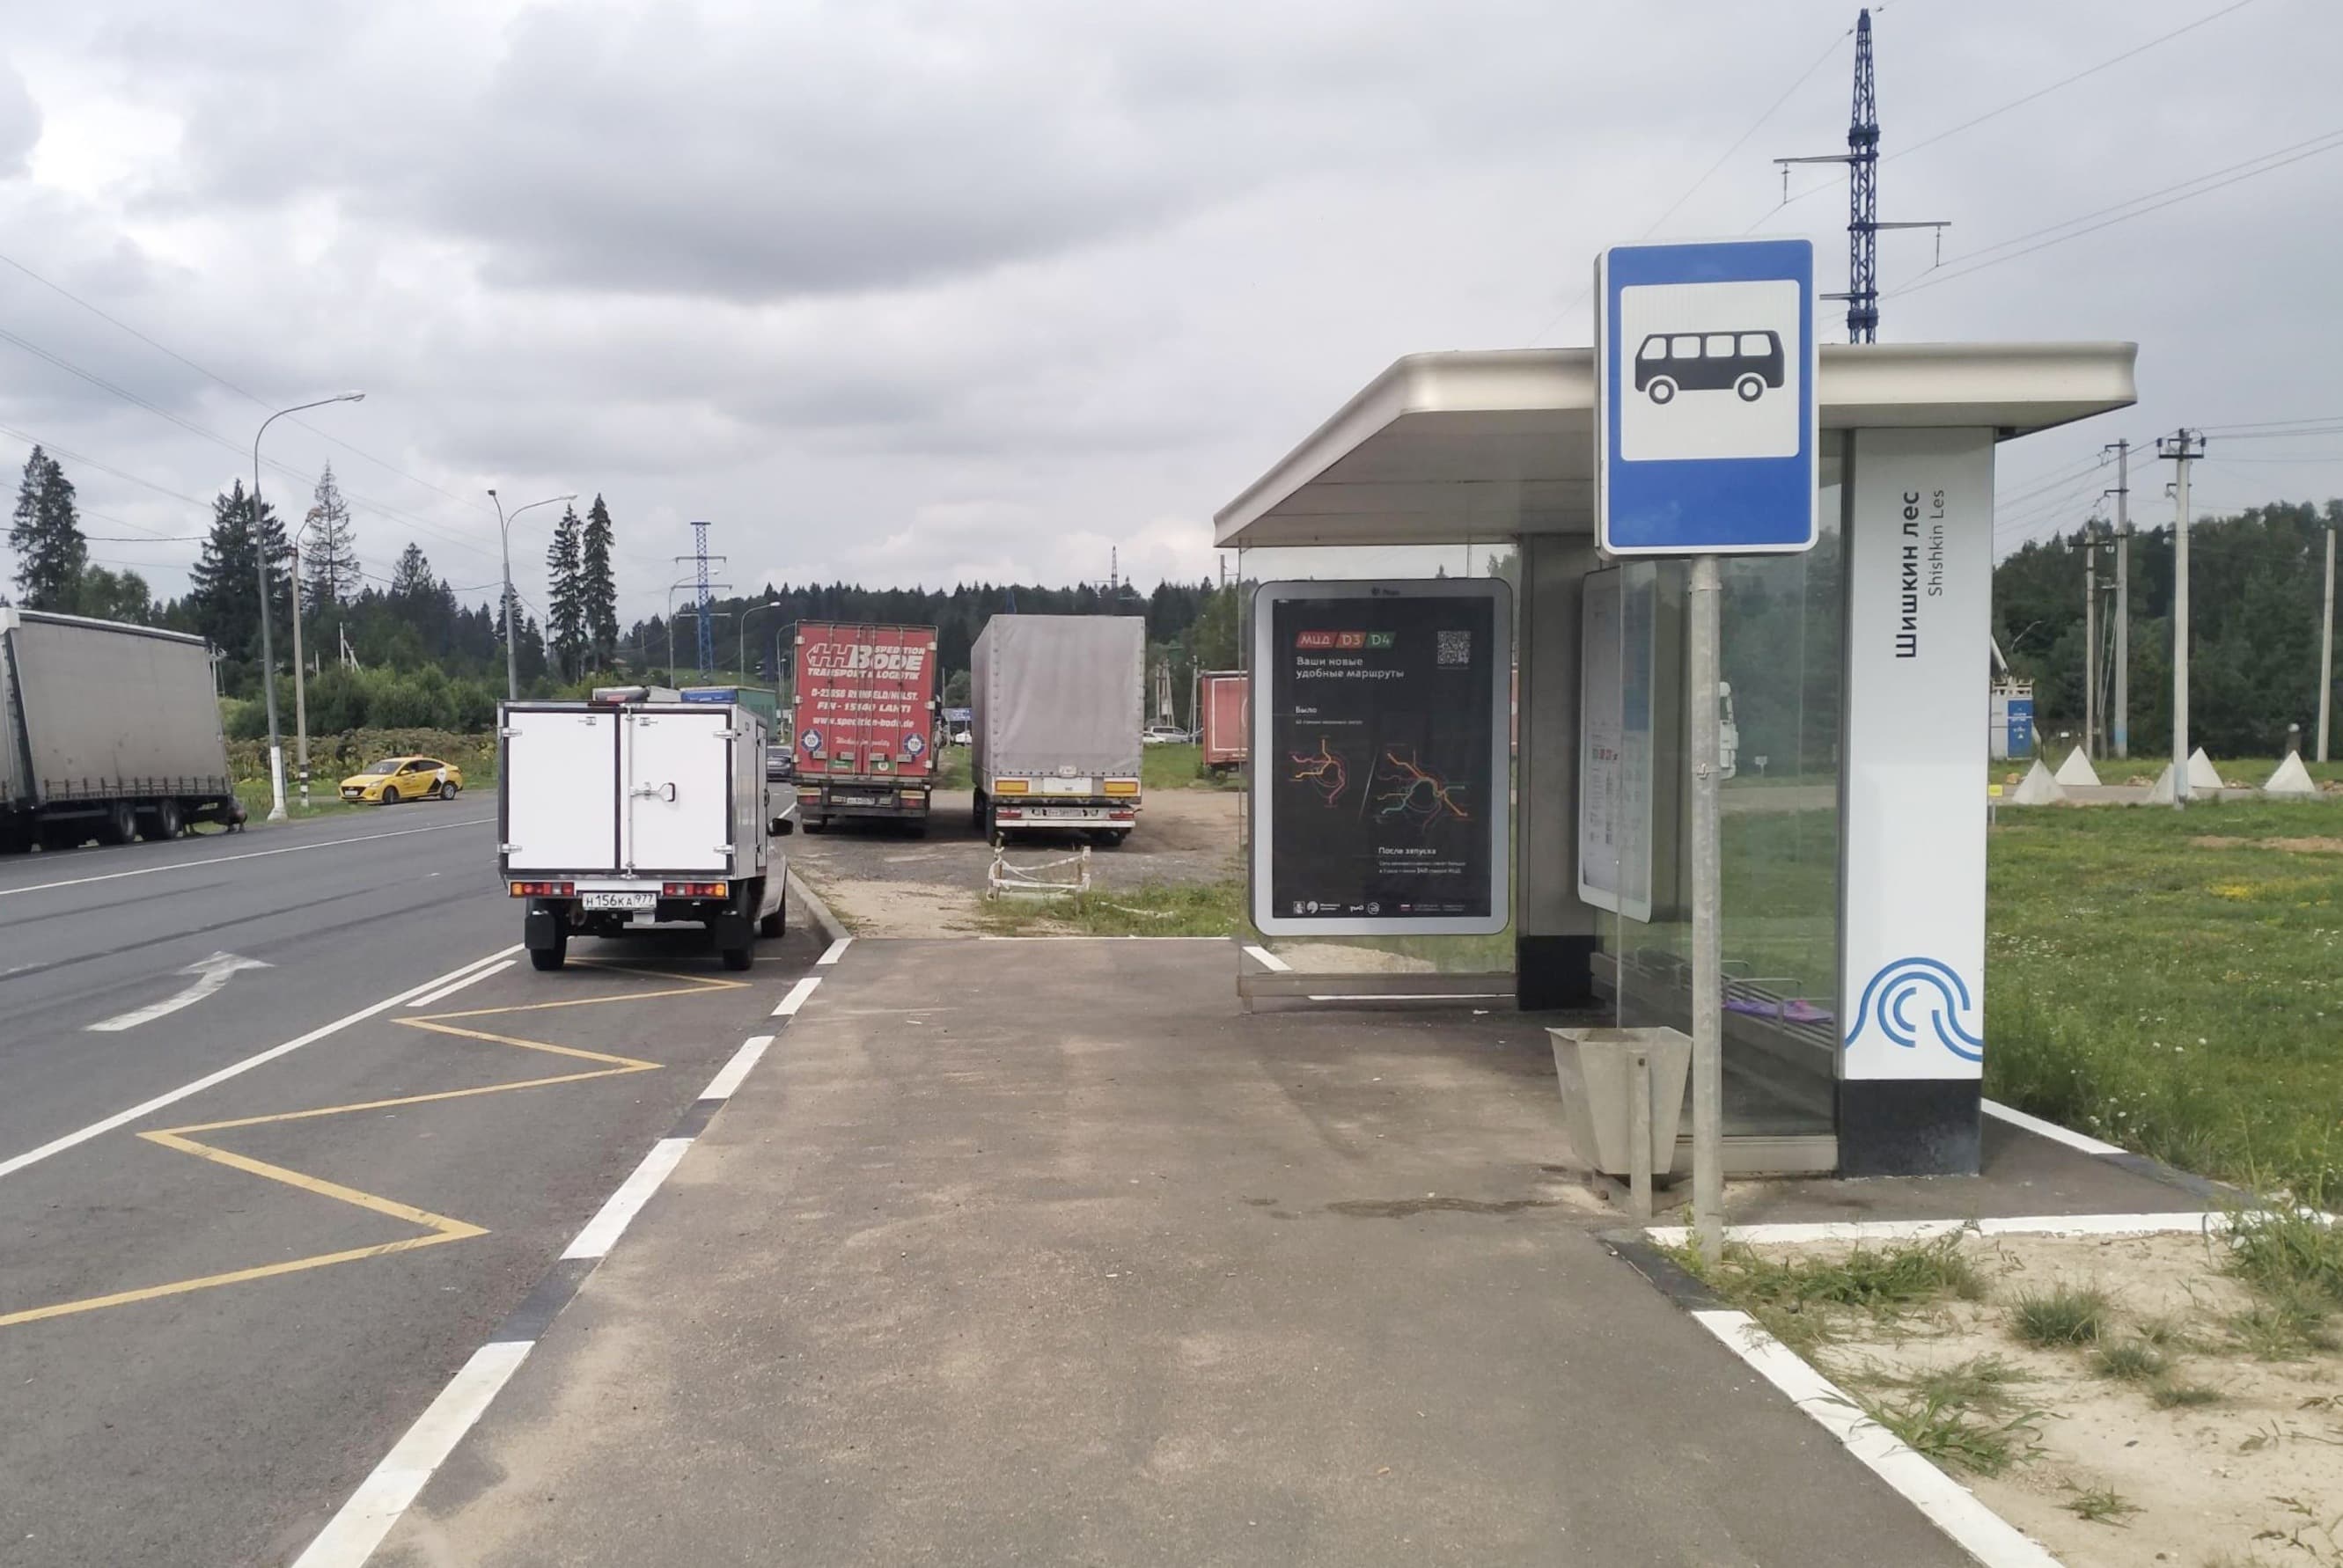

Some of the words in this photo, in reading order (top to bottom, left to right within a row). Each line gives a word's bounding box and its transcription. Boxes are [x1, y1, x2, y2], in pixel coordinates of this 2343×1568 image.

[1929, 489, 1944, 519] Les
[1903, 491, 1920, 537] лес
[1928, 525, 1943, 597] Shishkin
[1896, 546, 1918, 658] Шишкин
[1300, 634, 1331, 645] МЦД
[1342, 634, 1361, 646] D3
[1371, 634, 1390, 646] D4
[875, 645, 926, 656] SPEDTION
[1296, 656, 1326, 666] Ваши
[1328, 657, 1363, 666] новые
[807, 667, 866, 678] TRANSPORT
[1296, 668, 1344, 679] удобные
[1347, 670, 1404, 679] маршруты
